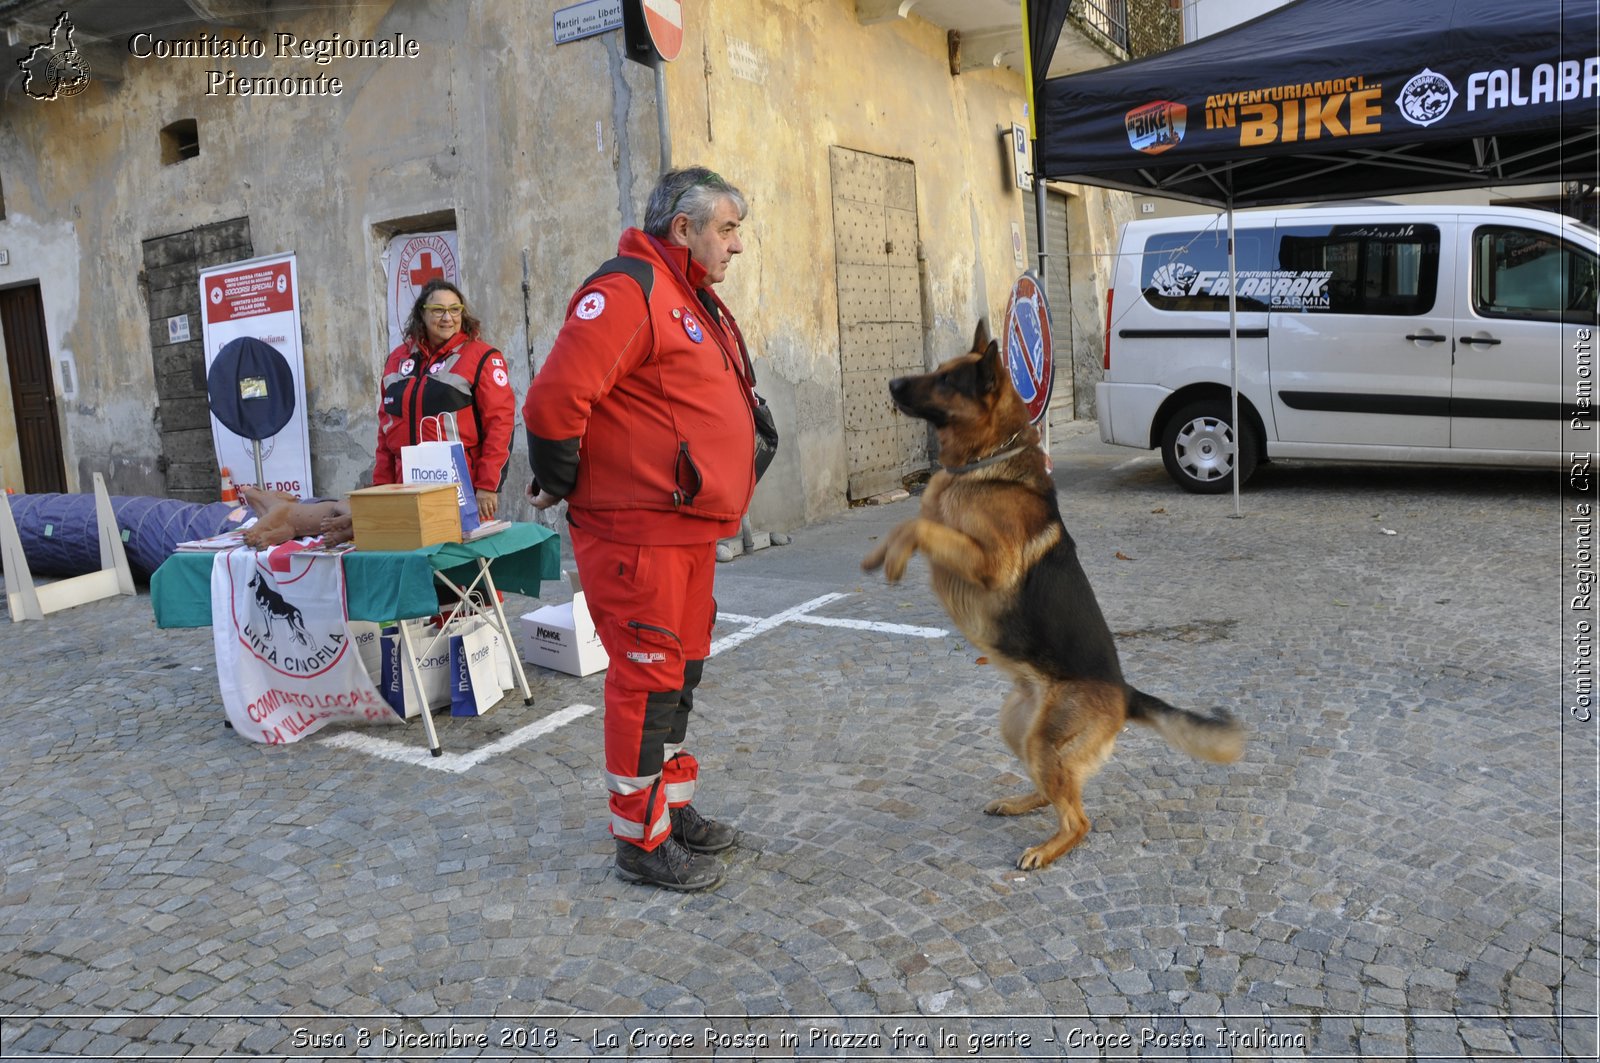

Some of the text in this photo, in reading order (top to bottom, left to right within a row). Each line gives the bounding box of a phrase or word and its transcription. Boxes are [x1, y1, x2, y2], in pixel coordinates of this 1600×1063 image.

[598, 6, 622, 19] Libert
[1135, 109, 1166, 138] BIKE
[1205, 89, 1382, 147] IN BIKE
[1188, 271, 1329, 297] FALABRAK
[1271, 296, 1330, 306] GARMIN
[276, 481, 300, 492] DOG
[284, 632, 344, 673] CINOFILA
[247, 689, 314, 723] COMITATO
[261, 726, 286, 746] DI
